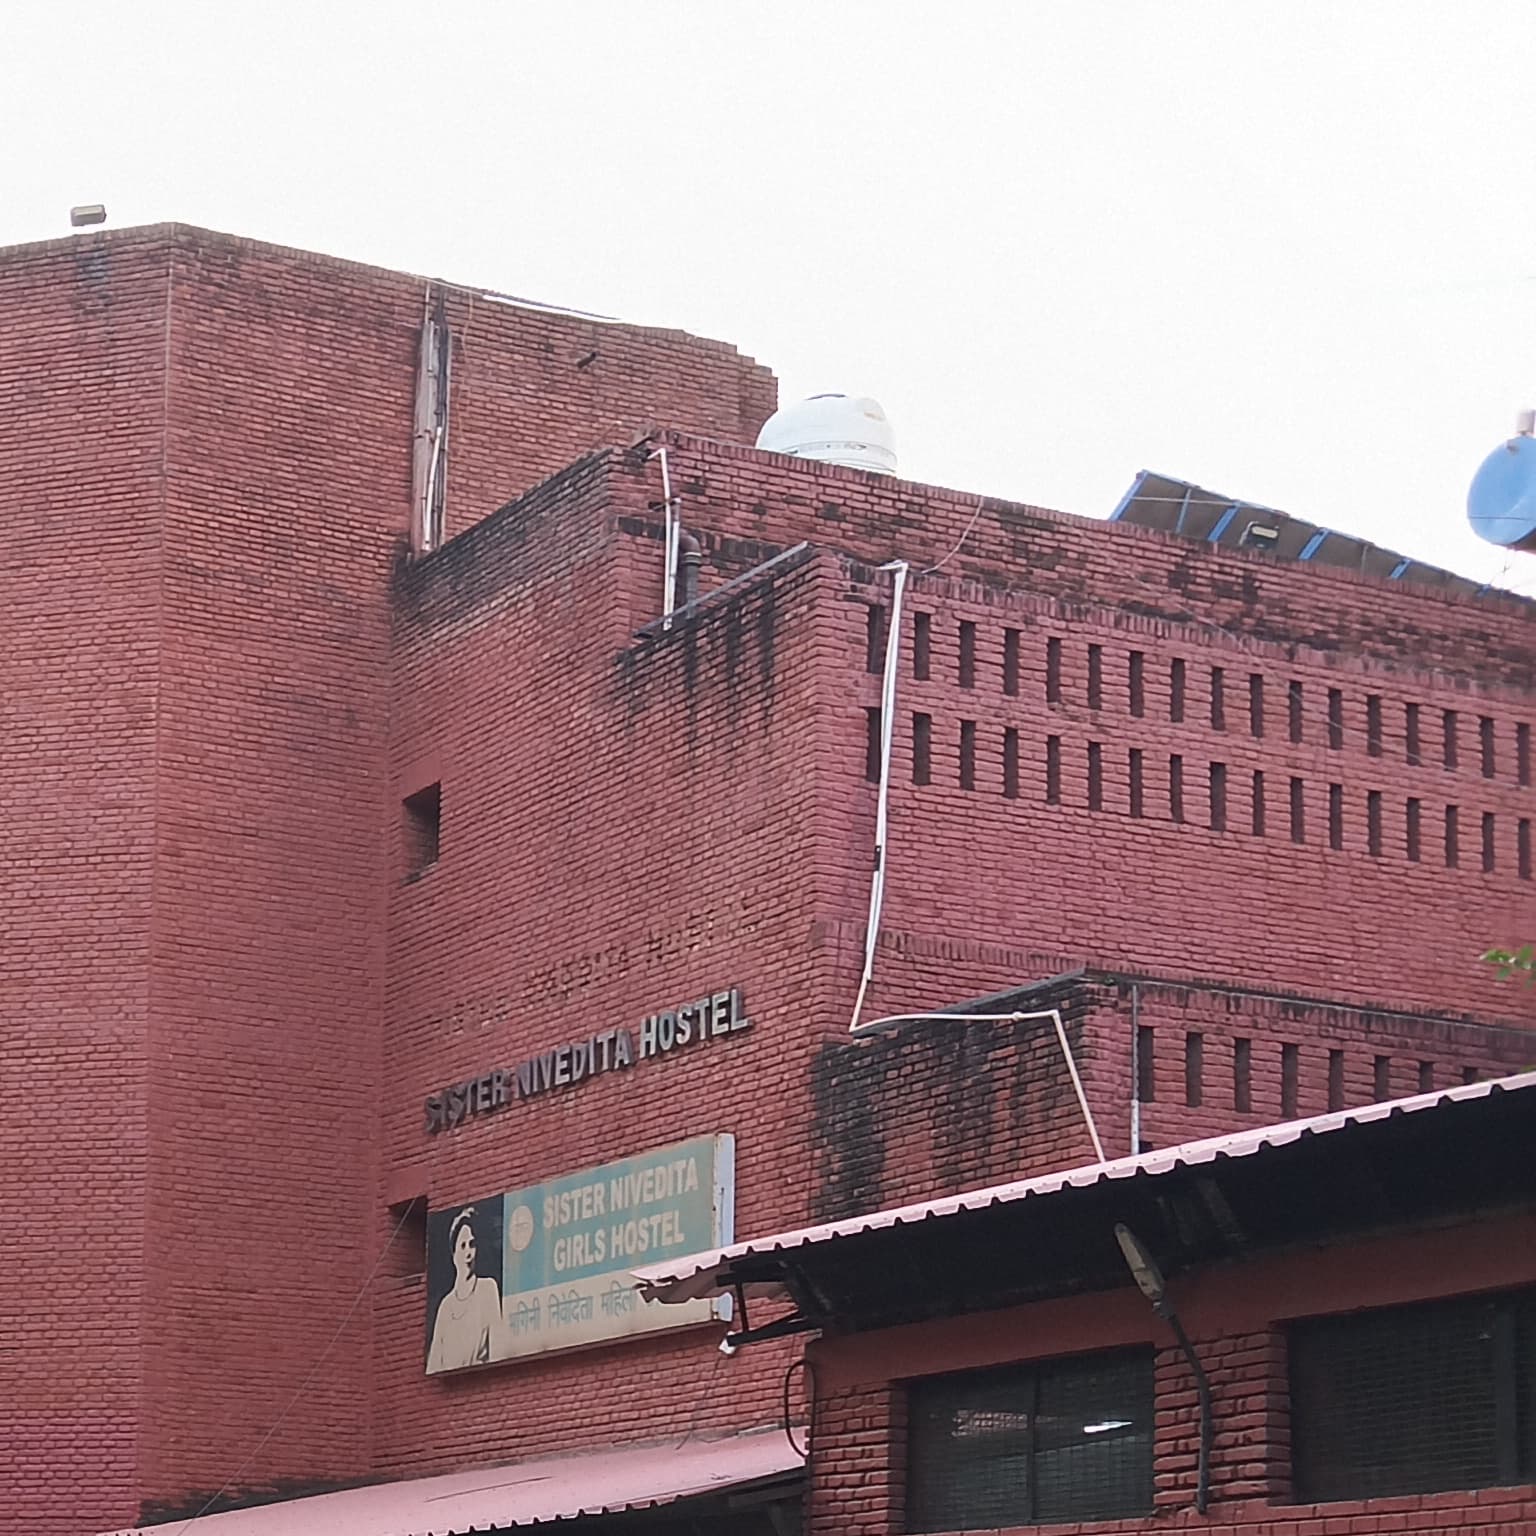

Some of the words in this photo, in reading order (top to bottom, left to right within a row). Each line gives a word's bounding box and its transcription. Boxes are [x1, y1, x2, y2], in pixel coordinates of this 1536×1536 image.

[425, 1068, 509, 1134] SISTER
[514, 1029, 635, 1099] NIVEDITA
[639, 987, 752, 1060] HOSTEL
[543, 1182, 606, 1229] SISTER
[611, 1157, 699, 1205] NIVEDITA
[554, 1231, 606, 1272] GIRLS
[611, 1210, 685, 1256] HOSTEL
[548, 1289, 593, 1329] निवेदिता
